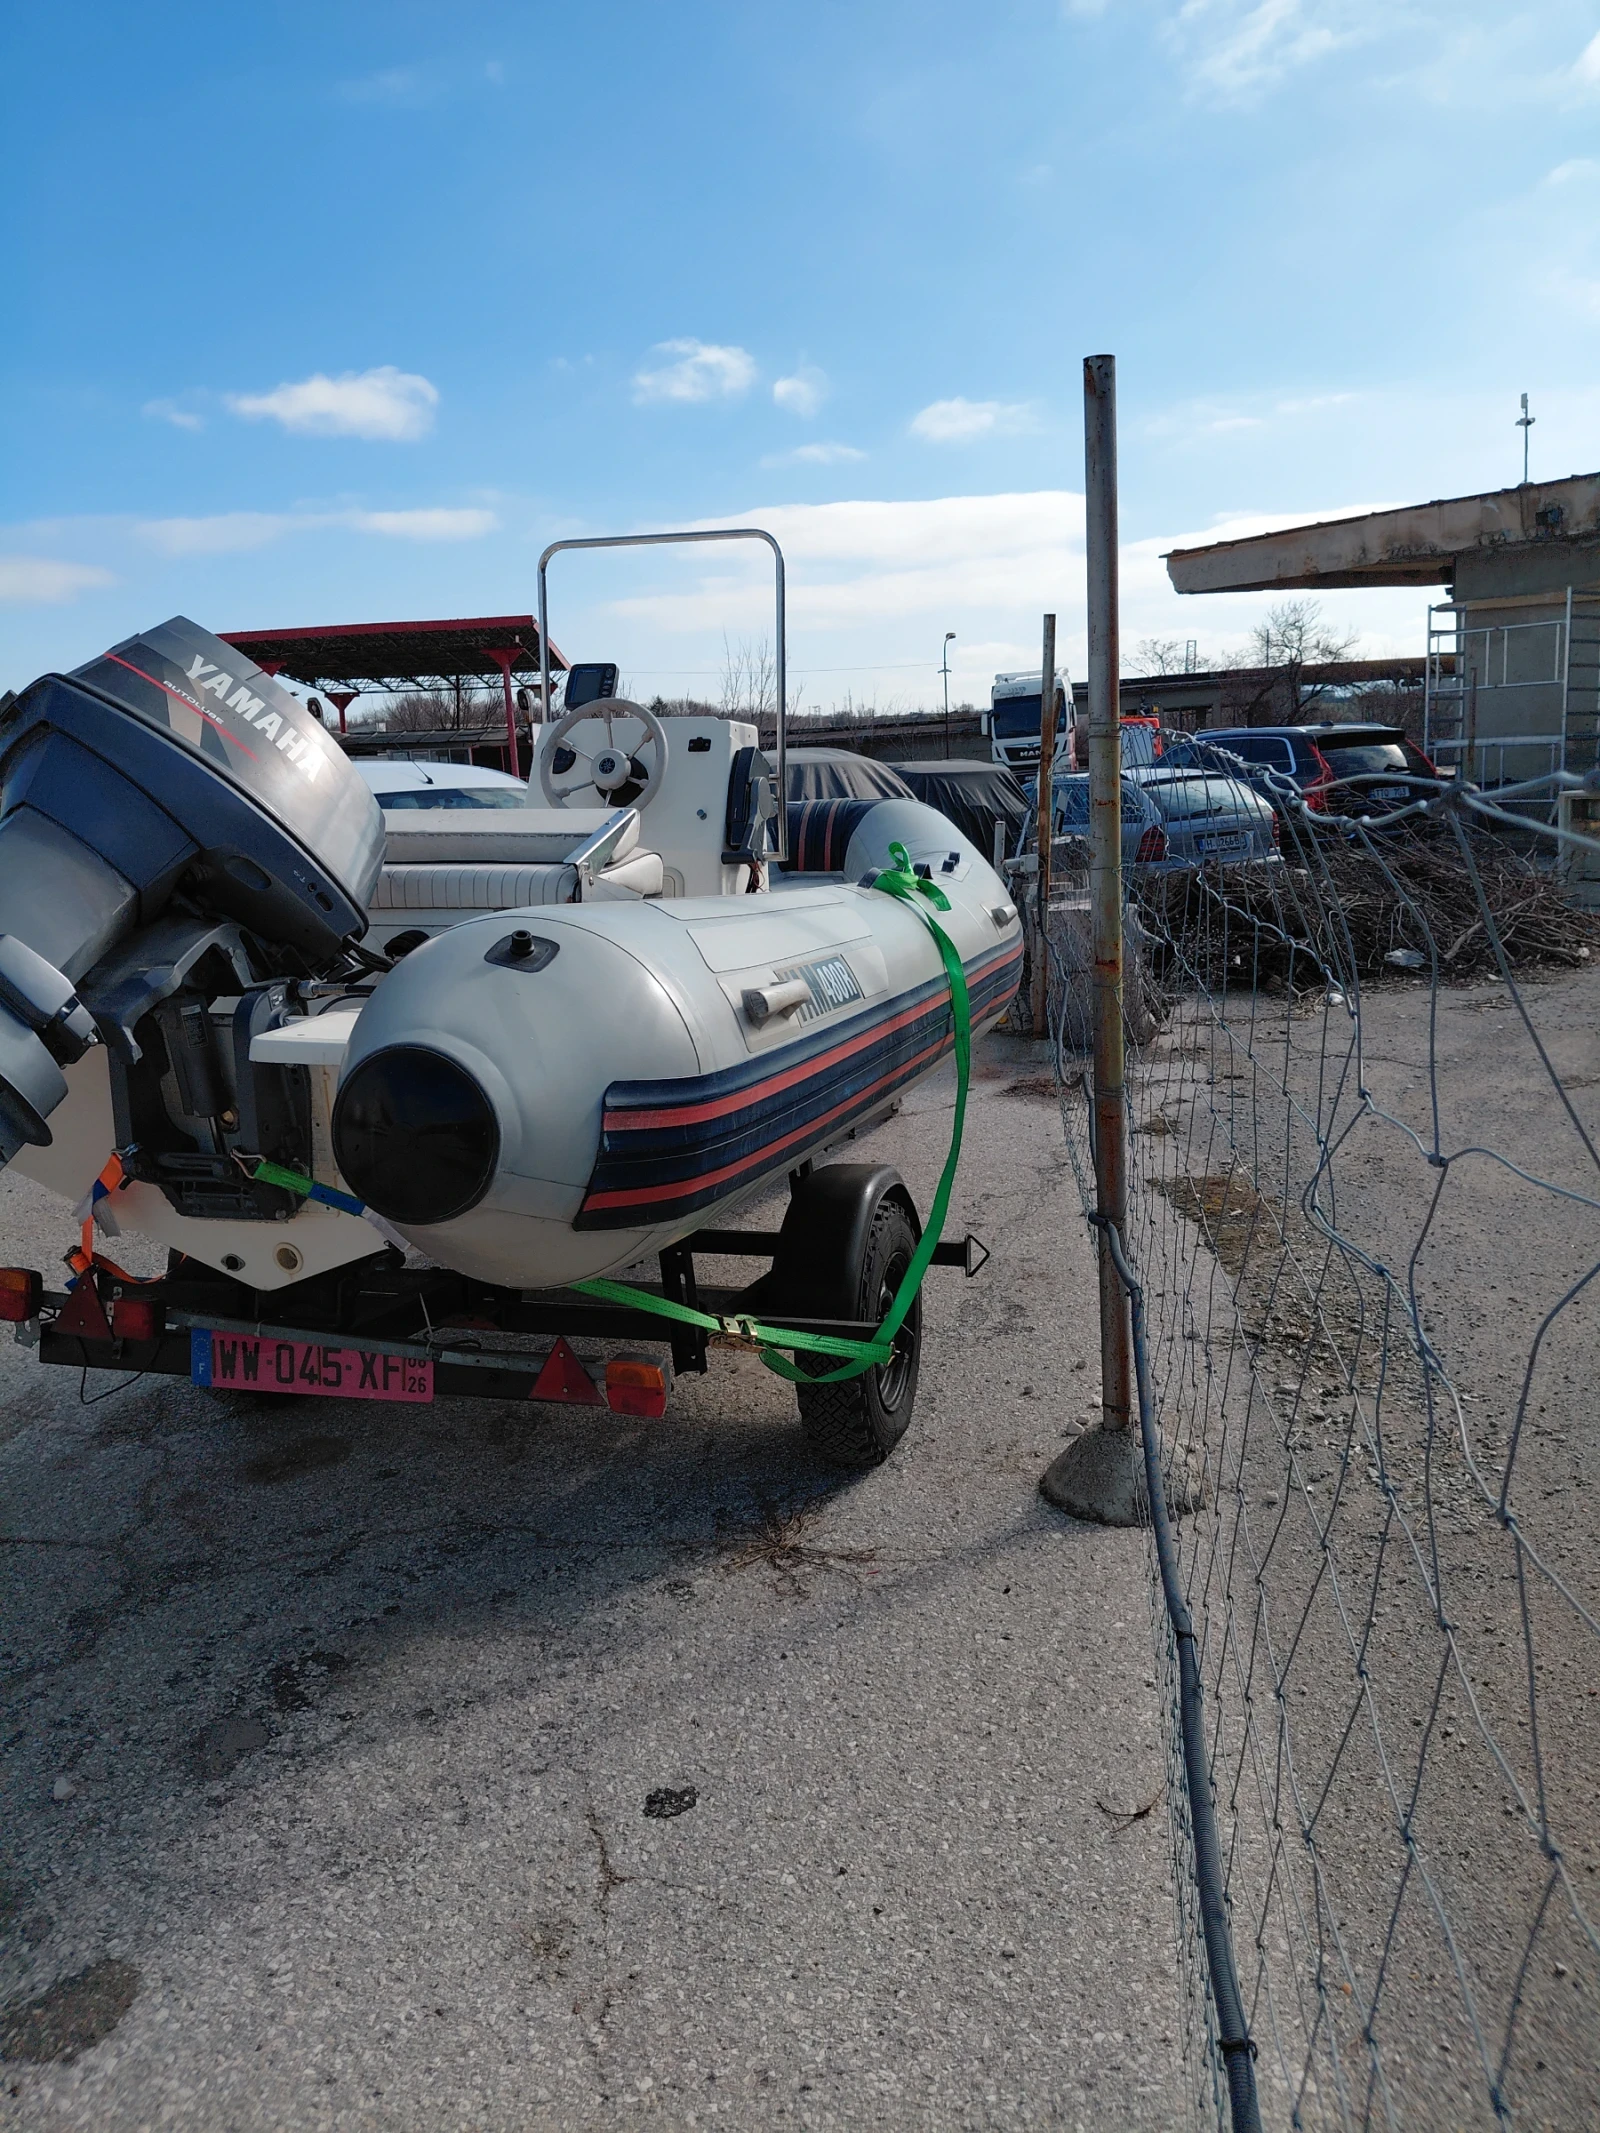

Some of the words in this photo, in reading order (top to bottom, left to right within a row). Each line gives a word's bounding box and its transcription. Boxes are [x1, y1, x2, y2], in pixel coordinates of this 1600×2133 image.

[163, 681, 224, 725] AUTOLUBE
[186, 654, 322, 783] YAMAHA
[816, 961, 858, 1004] 480R
[199, 1362, 205, 1375] F
[408, 1376, 427, 1393] 26
